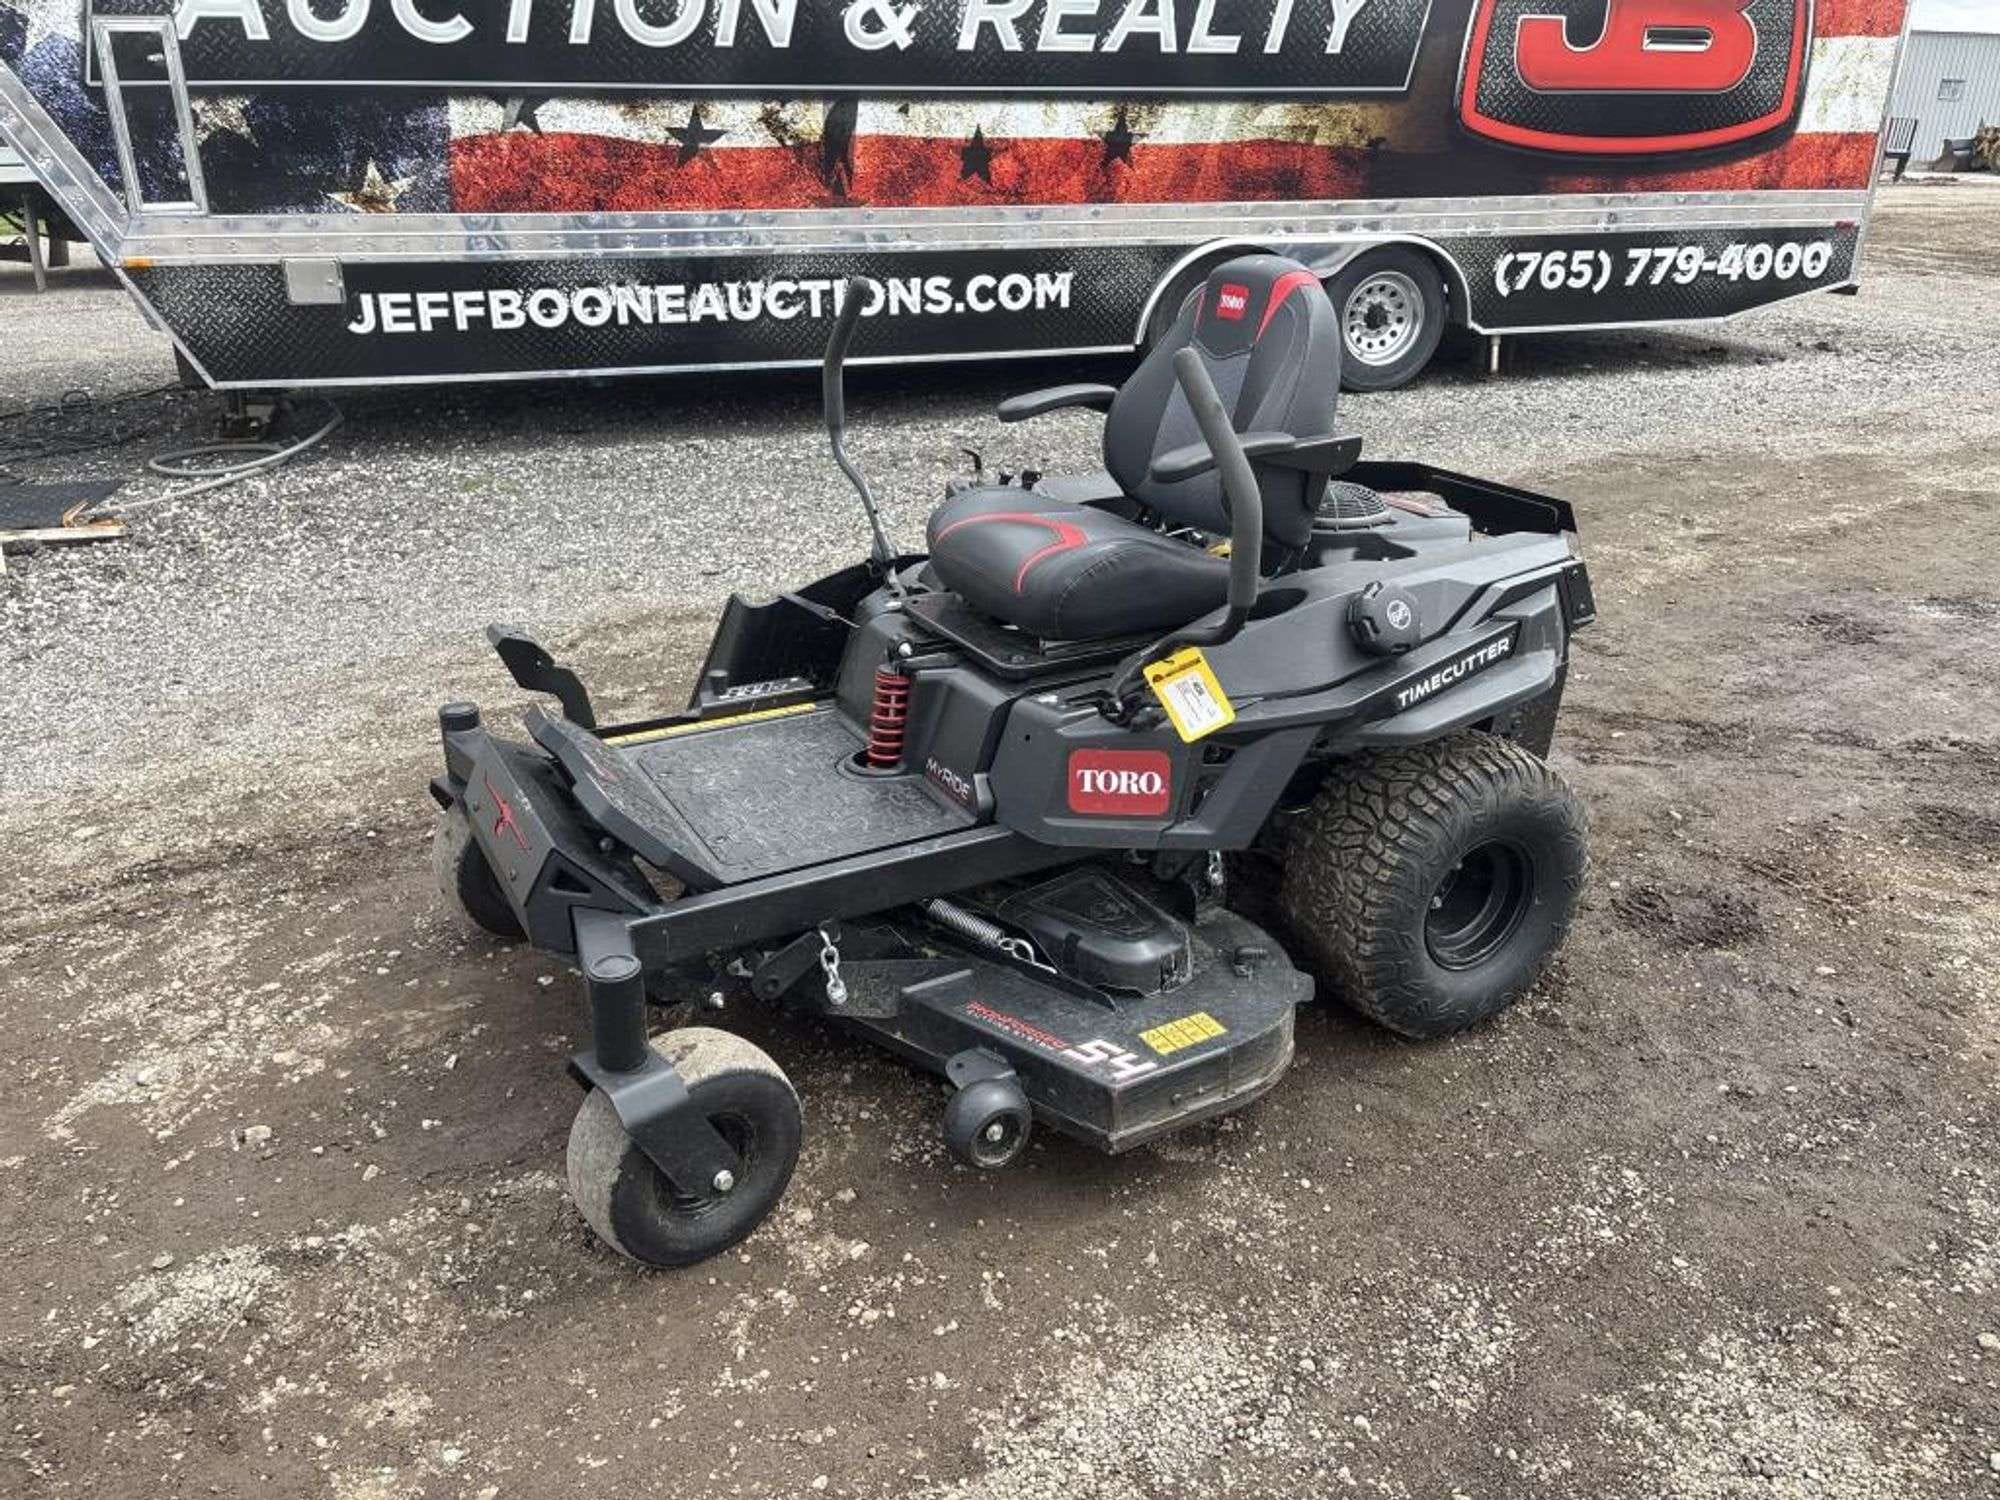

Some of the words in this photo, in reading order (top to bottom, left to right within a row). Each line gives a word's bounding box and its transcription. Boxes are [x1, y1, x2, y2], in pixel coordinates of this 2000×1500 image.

[844, 0, 922, 51] &
[1495, 248, 1612, 298] (765)
[1625, 241, 1834, 286] 779-4000
[348, 271, 1073, 334] JEFFBOONEAUCTIONS.COM
[1398, 637, 1510, 707] TIMECUTTER
[1076, 769, 1162, 794] TORO
[1063, 1039, 1157, 1079] 54
